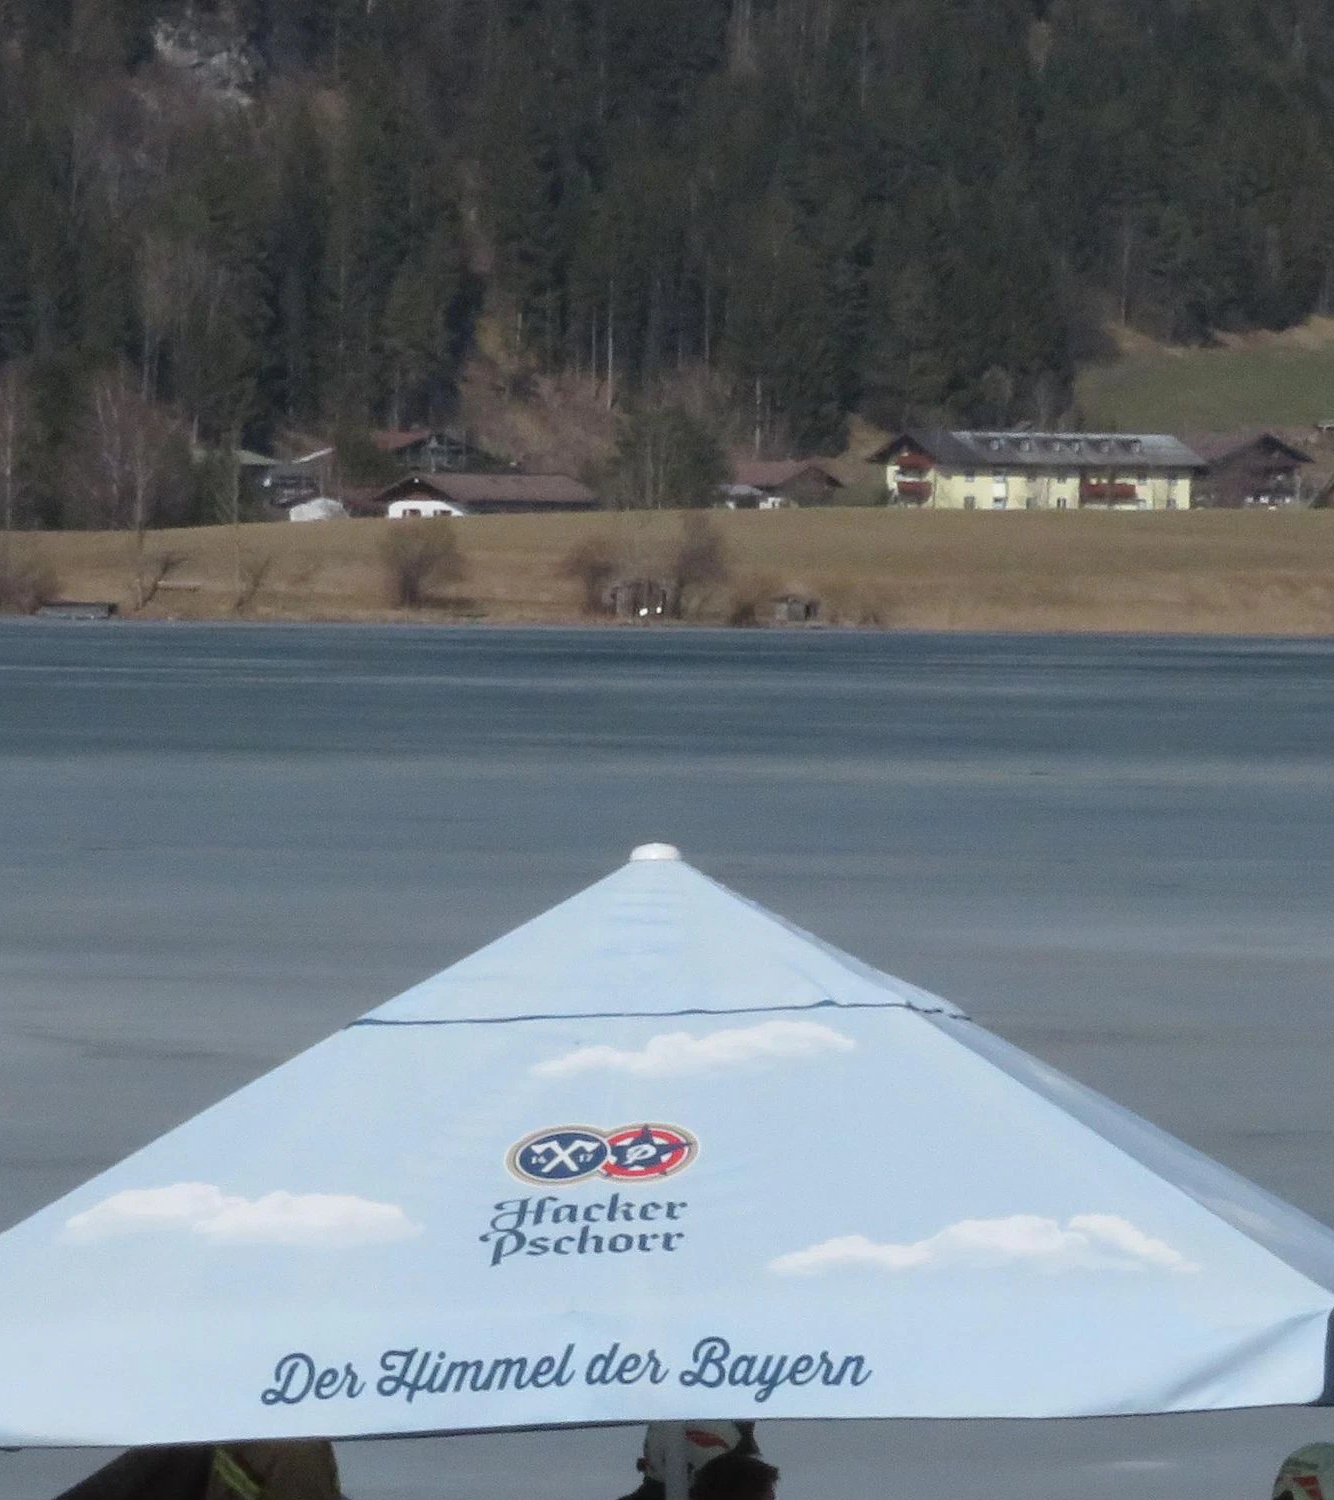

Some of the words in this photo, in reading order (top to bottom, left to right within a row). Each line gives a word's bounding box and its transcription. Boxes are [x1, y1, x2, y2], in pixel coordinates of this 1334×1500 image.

[490, 1192, 688, 1232] Hacker
[478, 1225, 684, 1267] Pschorr
[260, 1352, 366, 1405] Der
[376, 1342, 576, 1404] Himmel
[585, 1342, 669, 1386] der
[678, 1336, 873, 1403] Bayern
